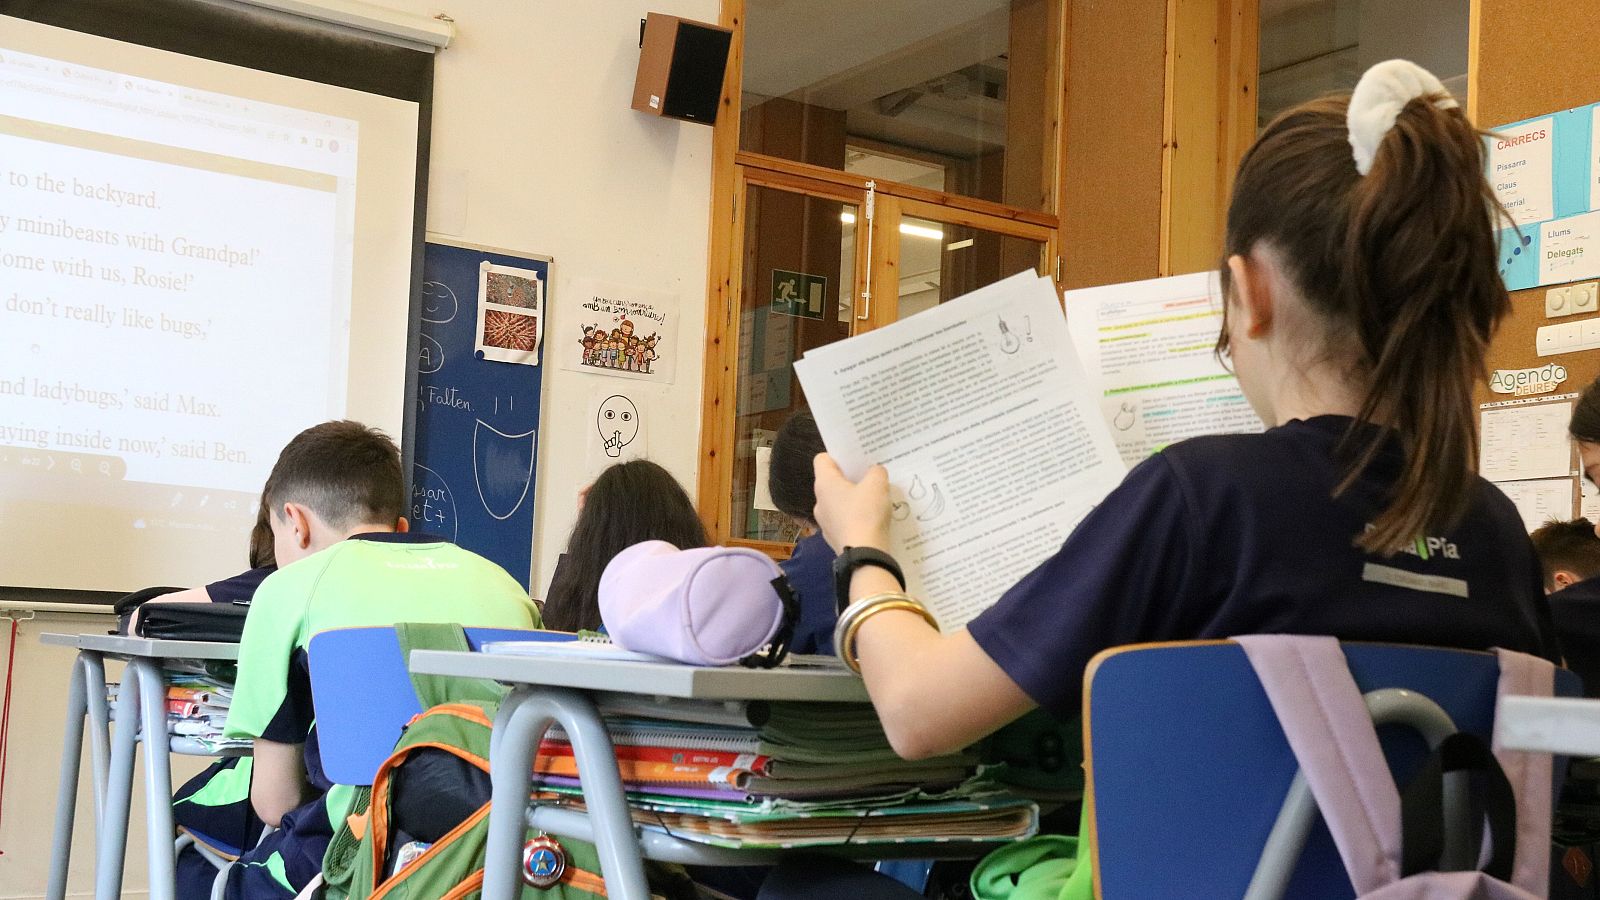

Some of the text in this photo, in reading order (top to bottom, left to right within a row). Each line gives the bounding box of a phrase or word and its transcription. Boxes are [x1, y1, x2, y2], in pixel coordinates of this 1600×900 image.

[1497, 129, 1546, 151] CARRECS
[1496, 158, 1526, 172] Pissarra
[9, 171, 161, 210] to the backyard.
[1497, 181, 1517, 191] Claus
[1499, 197, 1526, 209] aterial
[17, 216, 120, 247] minibeasts
[126, 231, 165, 253] with
[1547, 229, 1571, 238] Llums
[1547, 246, 1584, 260] Delegats
[0, 253, 46, 272] ome
[53, 256, 93, 278] with
[100, 264, 127, 286] us,
[64, 304, 117, 329] really
[122, 307, 155, 329] like
[1490, 364, 1566, 391] Agenda
[1516, 381, 1558, 396] DEURES
[133, 391, 170, 411] said
[176, 394, 222, 417] Max.
[427, 385, 475, 412] Falten.
[56, 425, 112, 450] inside
[171, 441, 207, 459] said
[214, 442, 252, 464] Ben.
